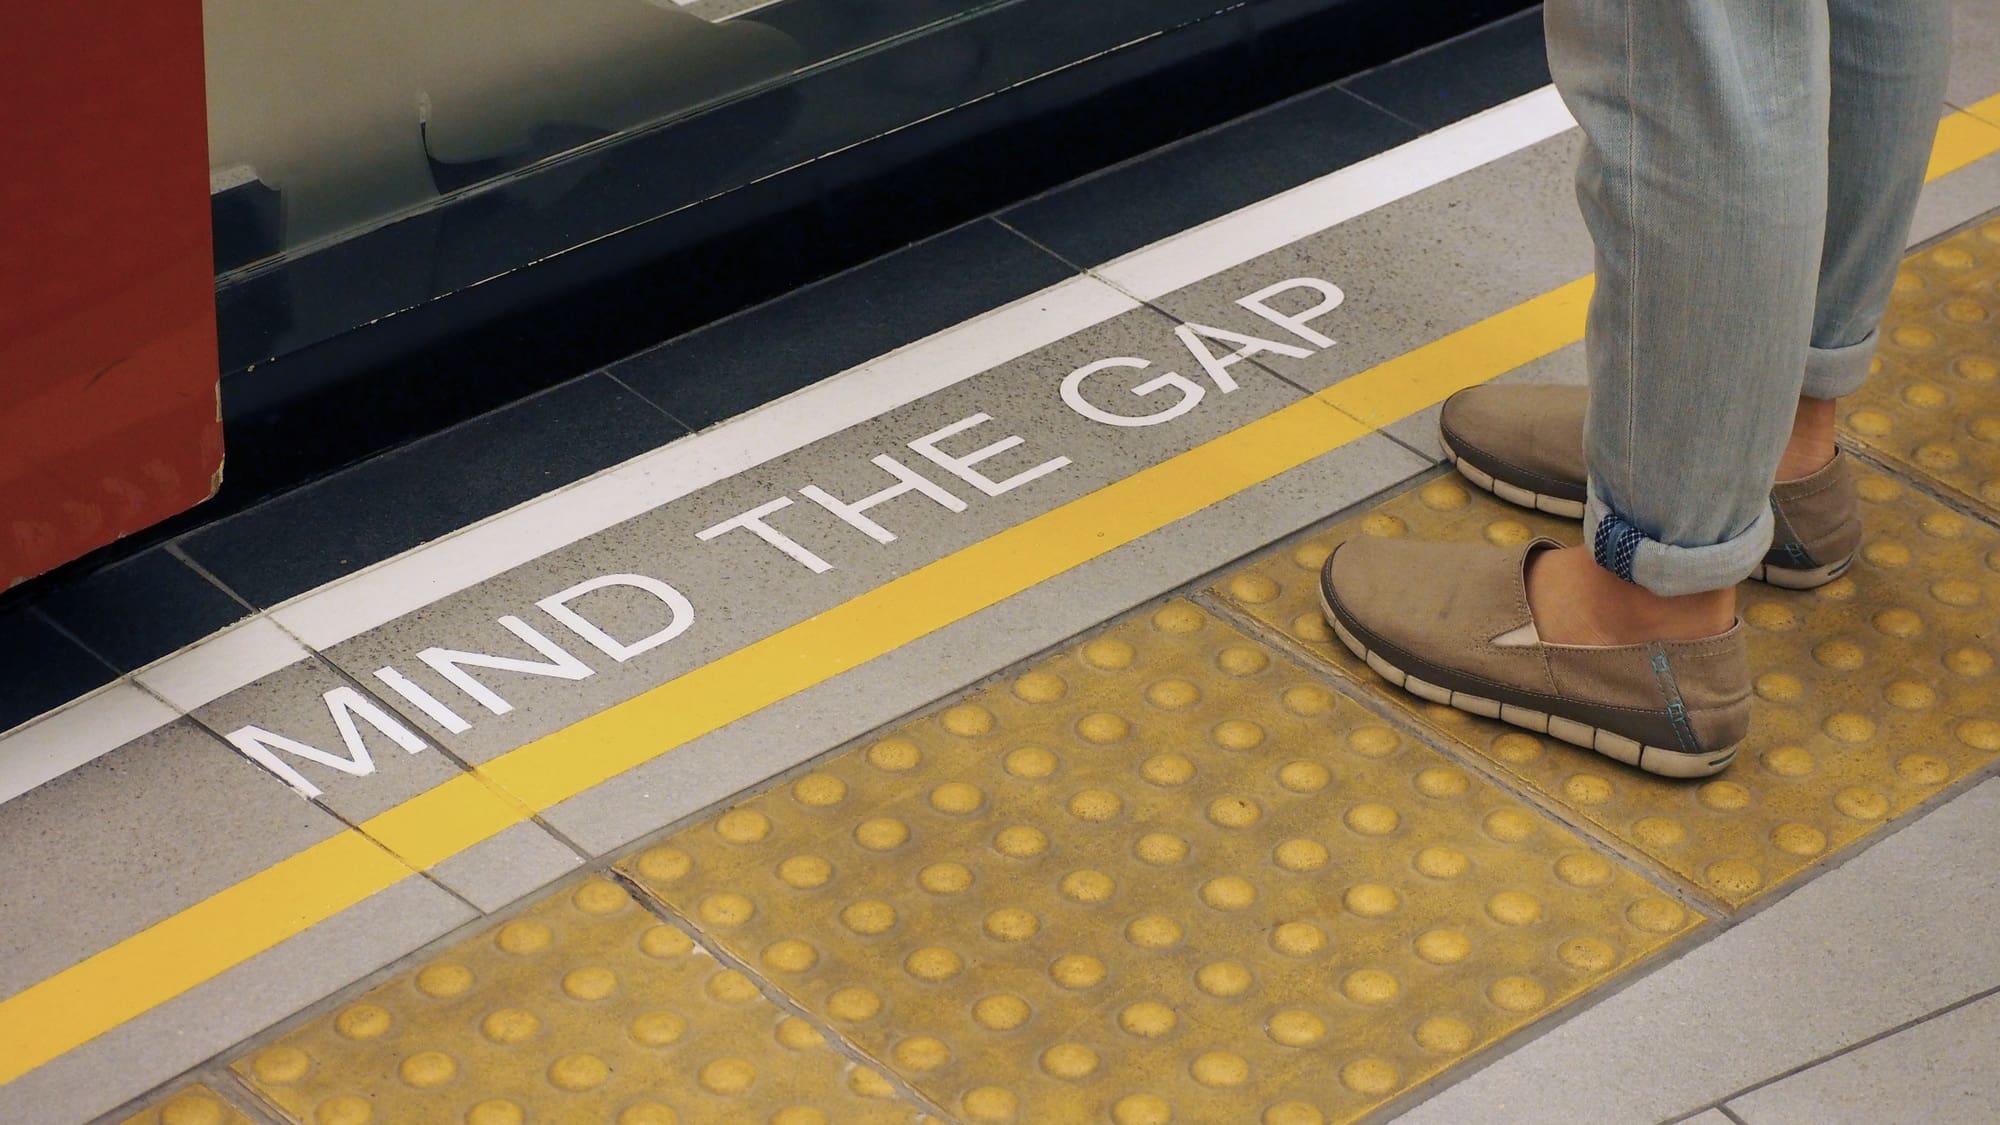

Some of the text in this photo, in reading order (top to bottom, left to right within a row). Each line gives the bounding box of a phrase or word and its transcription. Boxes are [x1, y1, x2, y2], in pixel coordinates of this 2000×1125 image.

[224, 277, 1346, 801] MIND THE GAP
